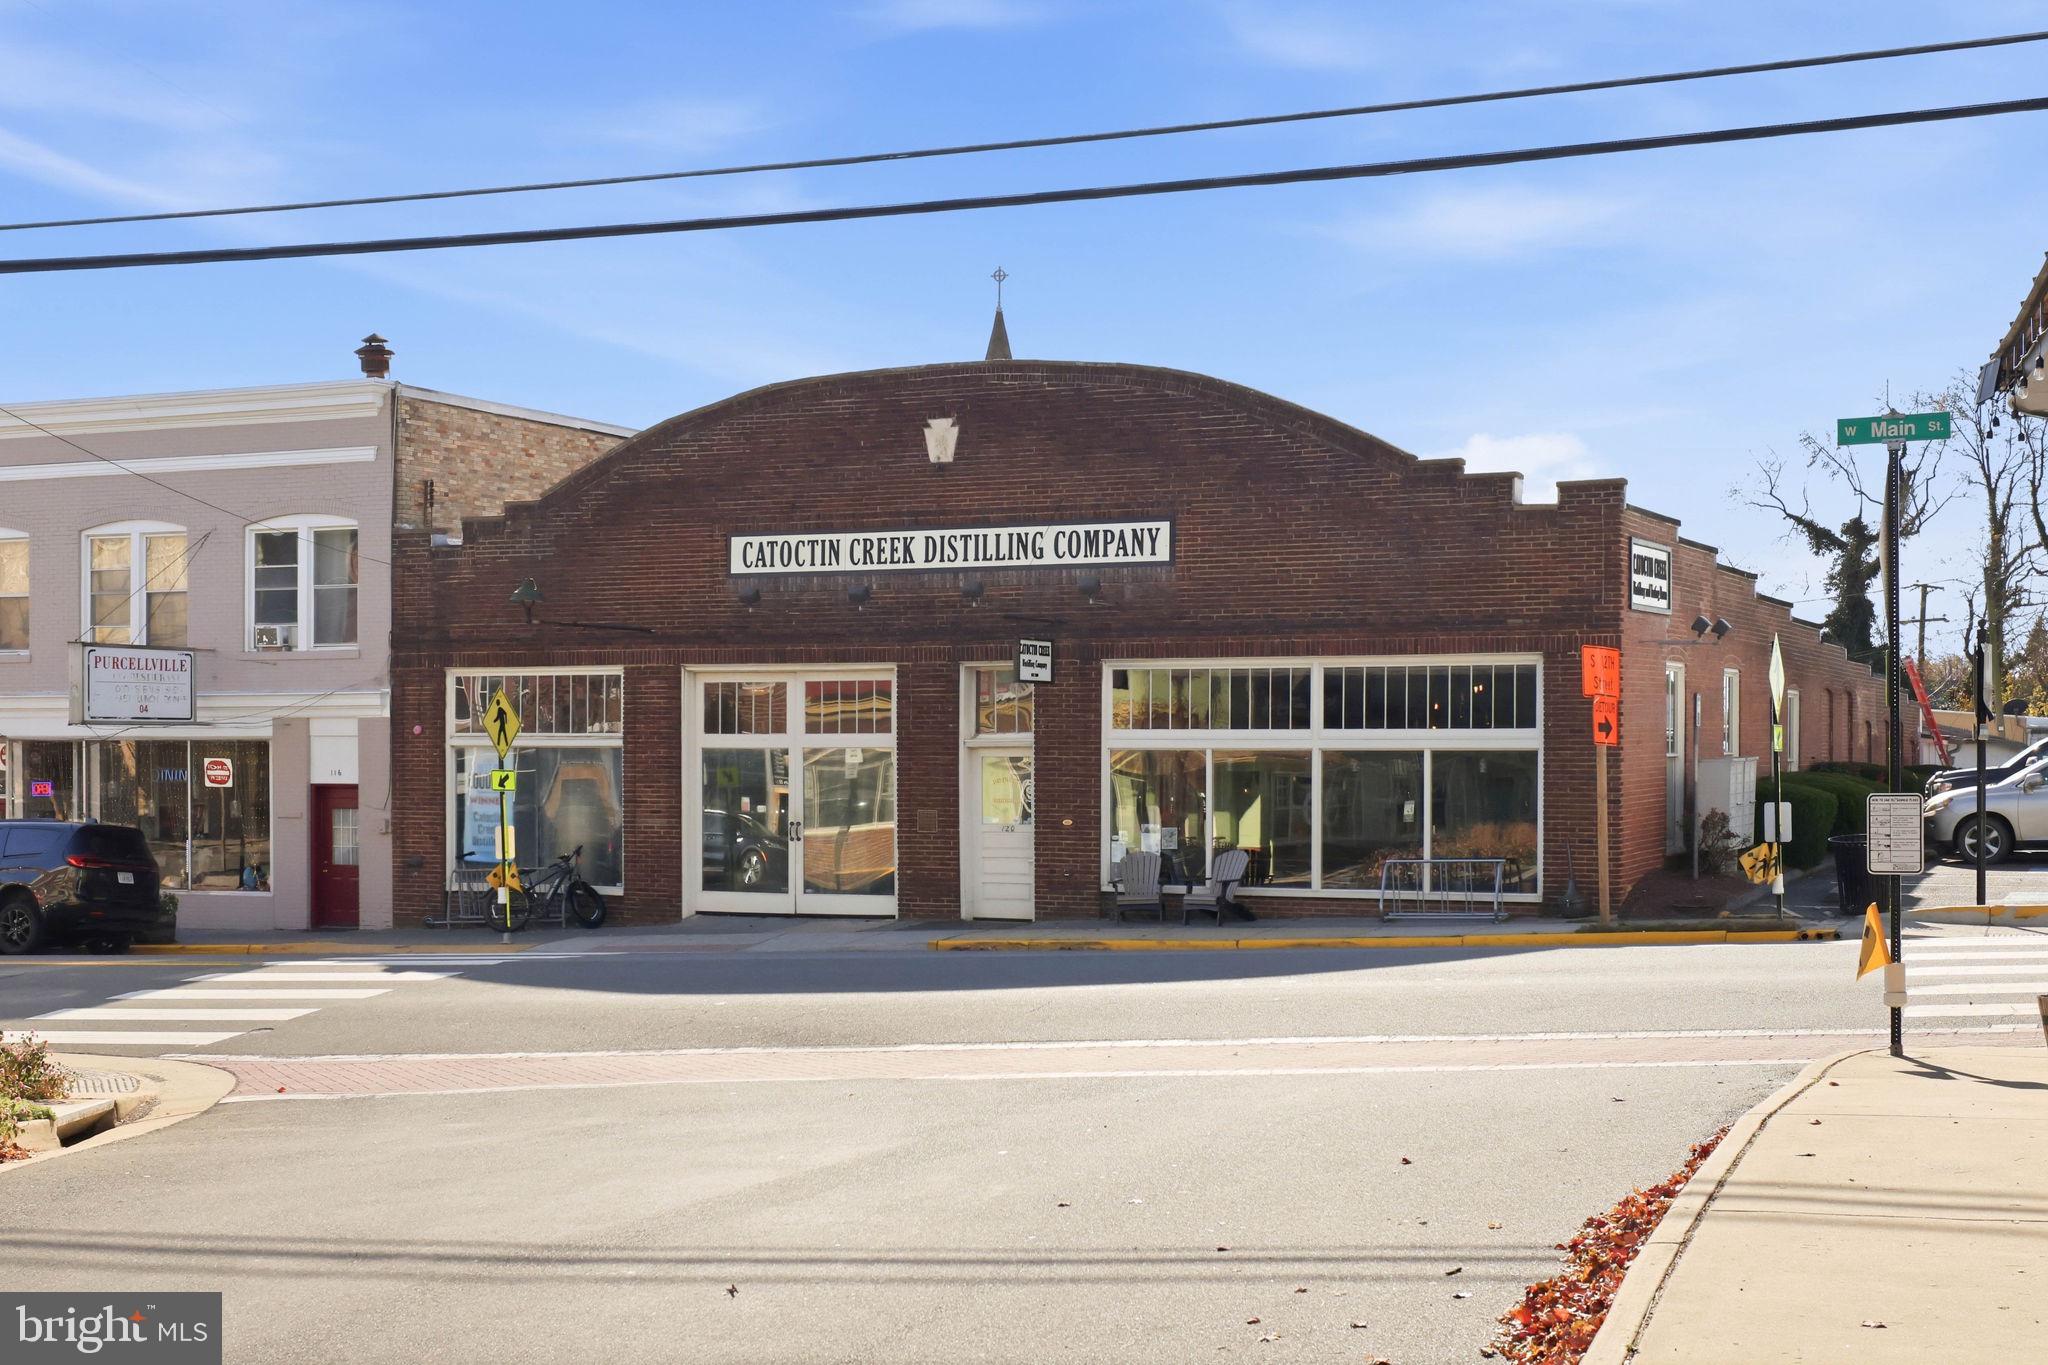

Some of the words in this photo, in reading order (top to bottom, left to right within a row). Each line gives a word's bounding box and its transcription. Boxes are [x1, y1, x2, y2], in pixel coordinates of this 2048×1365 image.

[1844, 426, 1857, 436] W
[1871, 421, 1915, 437] Main
[1928, 421, 1944, 431] St.
[742, 539, 840, 568] CATOCTIN
[849, 536, 915, 565] CREEK
[924, 531, 1044, 563] DISTILLING
[1053, 527, 1160, 559] COMPANY
[94, 655, 187, 672] PURCELLVILLE
[470, 796, 500, 805] WINNE
